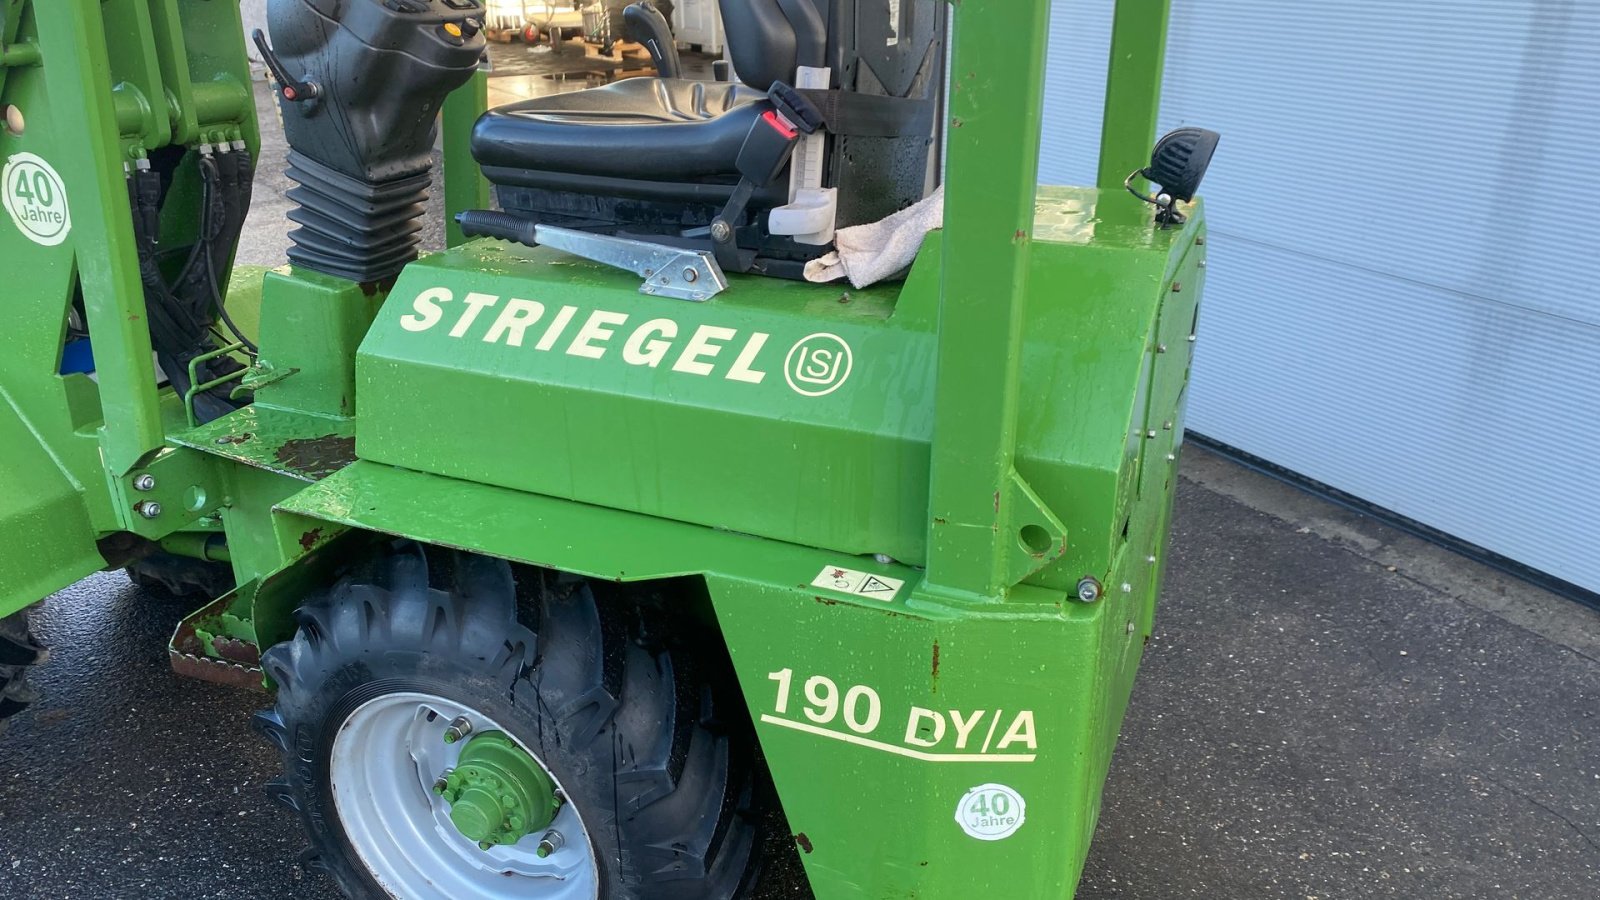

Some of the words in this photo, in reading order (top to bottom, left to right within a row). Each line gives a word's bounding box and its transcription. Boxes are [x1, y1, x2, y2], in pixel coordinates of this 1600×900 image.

[15, 169, 53, 207] 40
[20, 204, 63, 224] Jahre
[400, 287, 770, 384] STRIEGEL
[768, 668, 881, 734] 190
[904, 706, 1038, 753] DY/A
[969, 792, 1010, 817] 40
[971, 814, 1016, 828] Jahre
